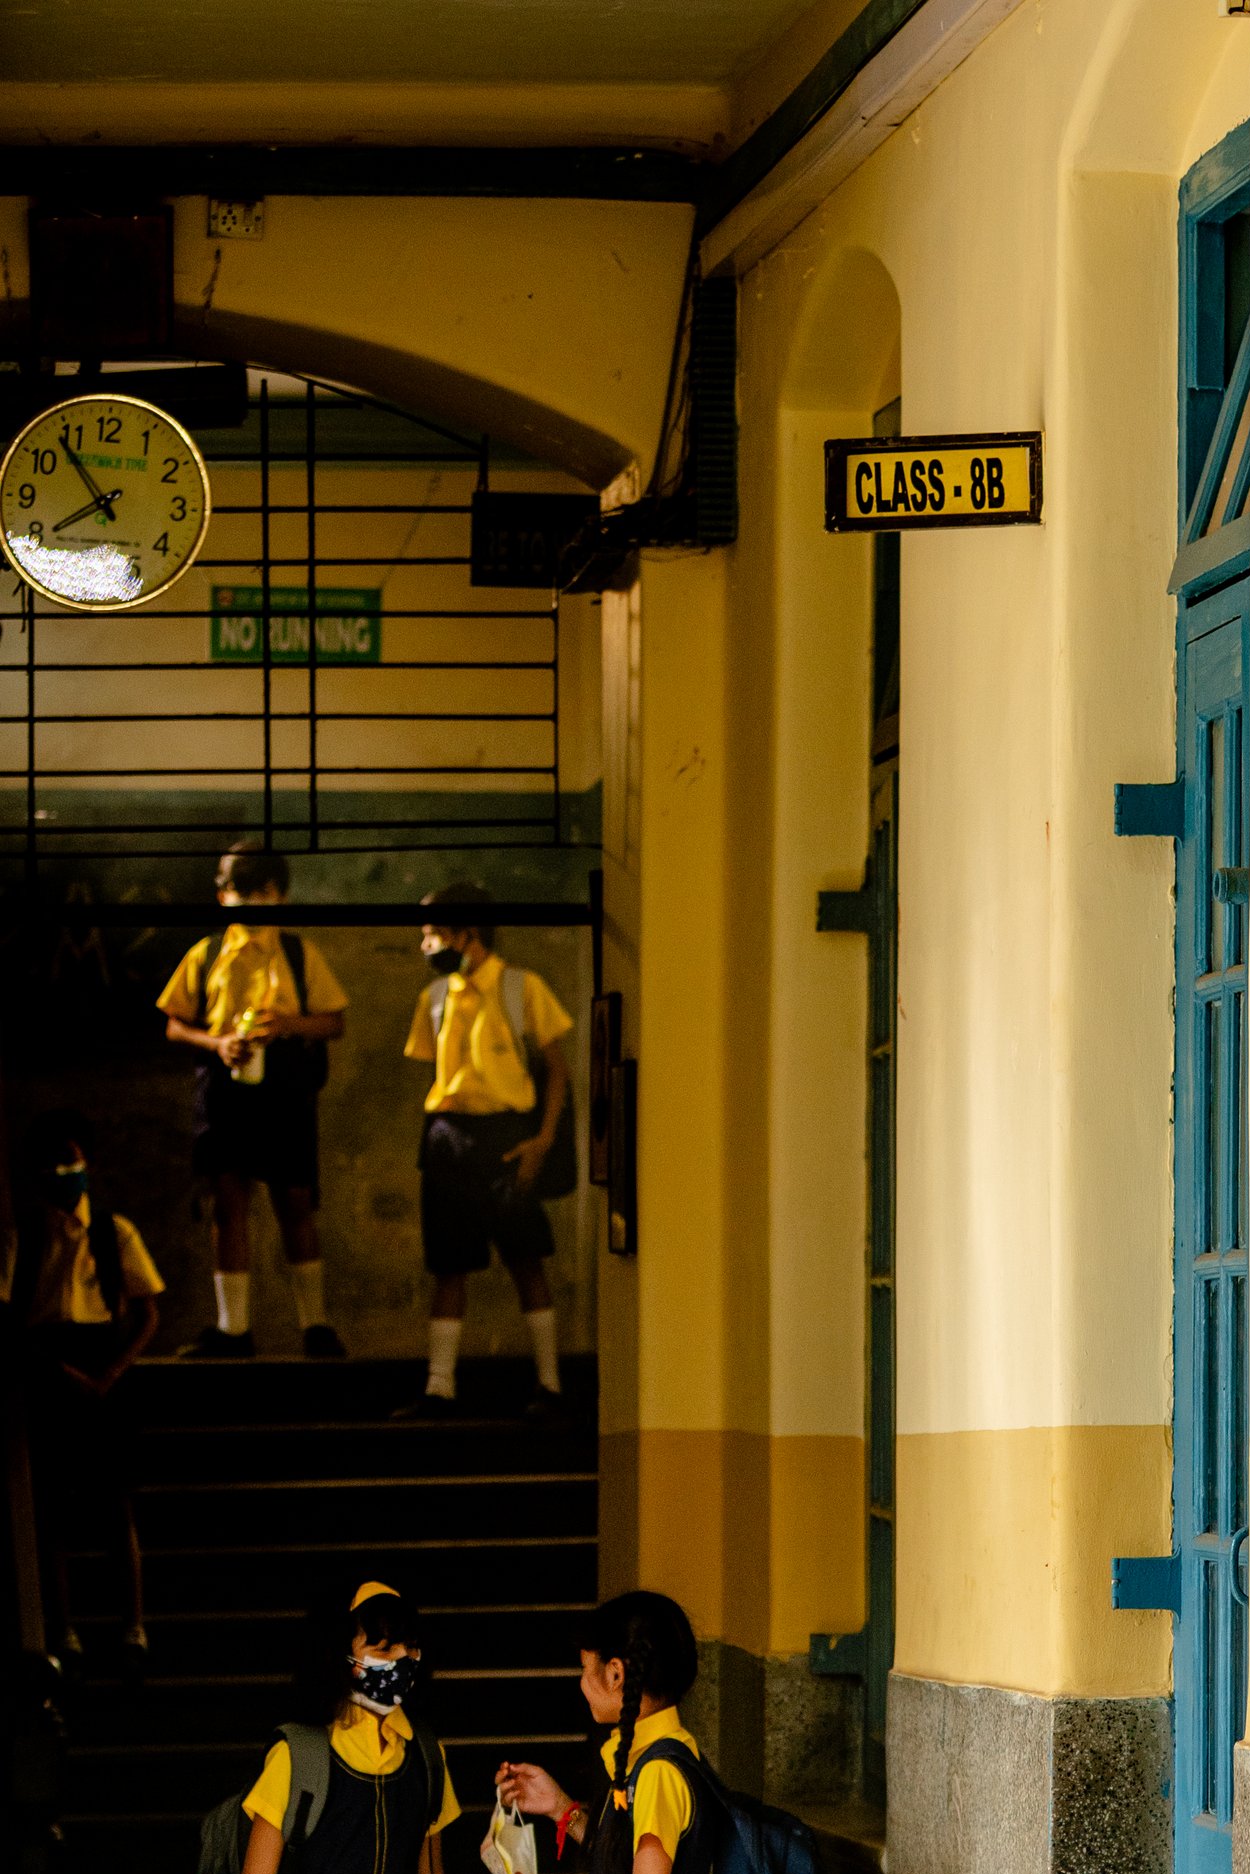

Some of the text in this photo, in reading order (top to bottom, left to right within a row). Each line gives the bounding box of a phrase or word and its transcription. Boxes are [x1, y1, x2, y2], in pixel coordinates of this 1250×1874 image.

[61, 424, 83, 450] 11
[97, 417, 122, 443] 12
[142, 430, 150, 456] 1
[31, 448, 57, 475] 10
[160, 458, 180, 484] 2
[18, 484, 36, 510] 9
[856, 458, 946, 514] CLASS
[970, 457, 1005, 510] 8B
[170, 496, 186, 522] 3
[152, 532, 170, 557] 4
[220, 615, 256, 651] NO
